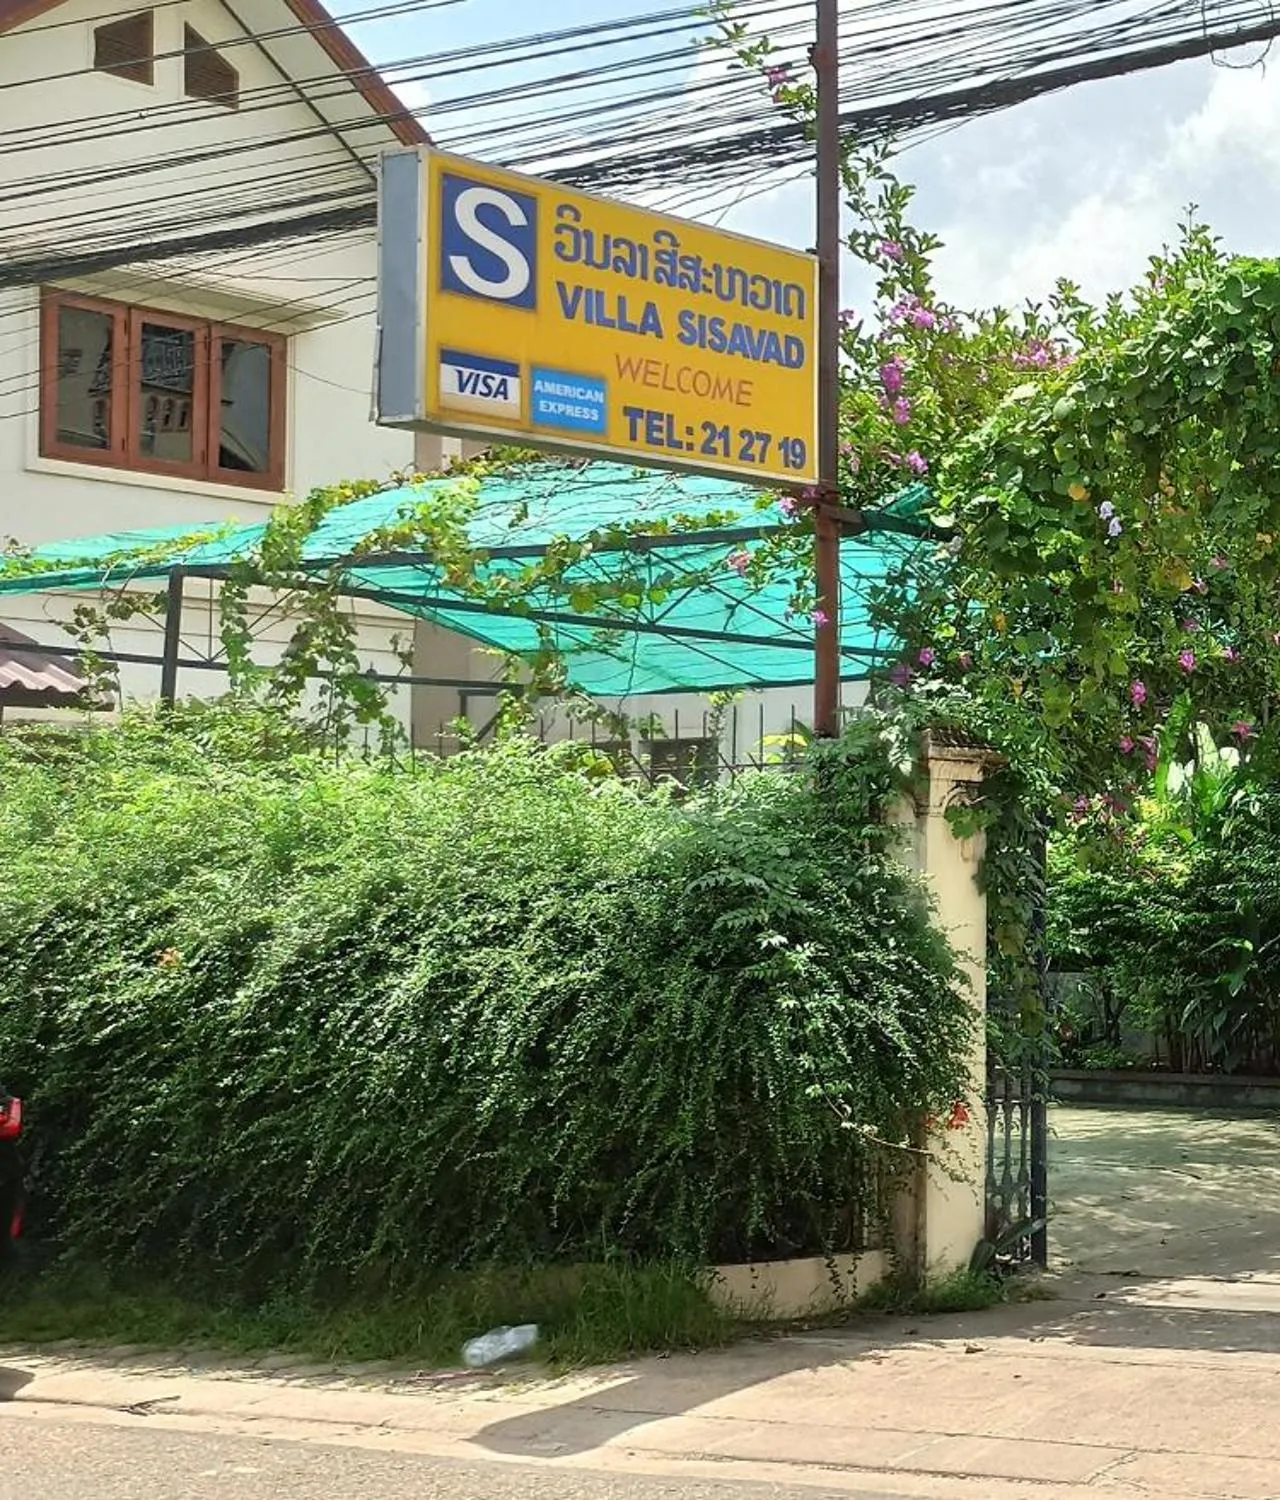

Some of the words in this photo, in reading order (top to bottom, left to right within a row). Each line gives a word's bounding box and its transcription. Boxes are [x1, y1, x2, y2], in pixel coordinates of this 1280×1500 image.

[449, 187, 530, 299] S
[556, 281, 664, 339] VILLA
[677, 309, 805, 369] SISAVAD
[455, 369, 509, 400] VISA
[534, 380, 604, 402] AMERICAN
[615, 355, 753, 406] WELCOME
[539, 400, 599, 421] EXPRESS
[623, 405, 695, 451] TEL:
[701, 421, 731, 458] 21
[739, 428, 772, 463] 27
[778, 436, 806, 470] 19
